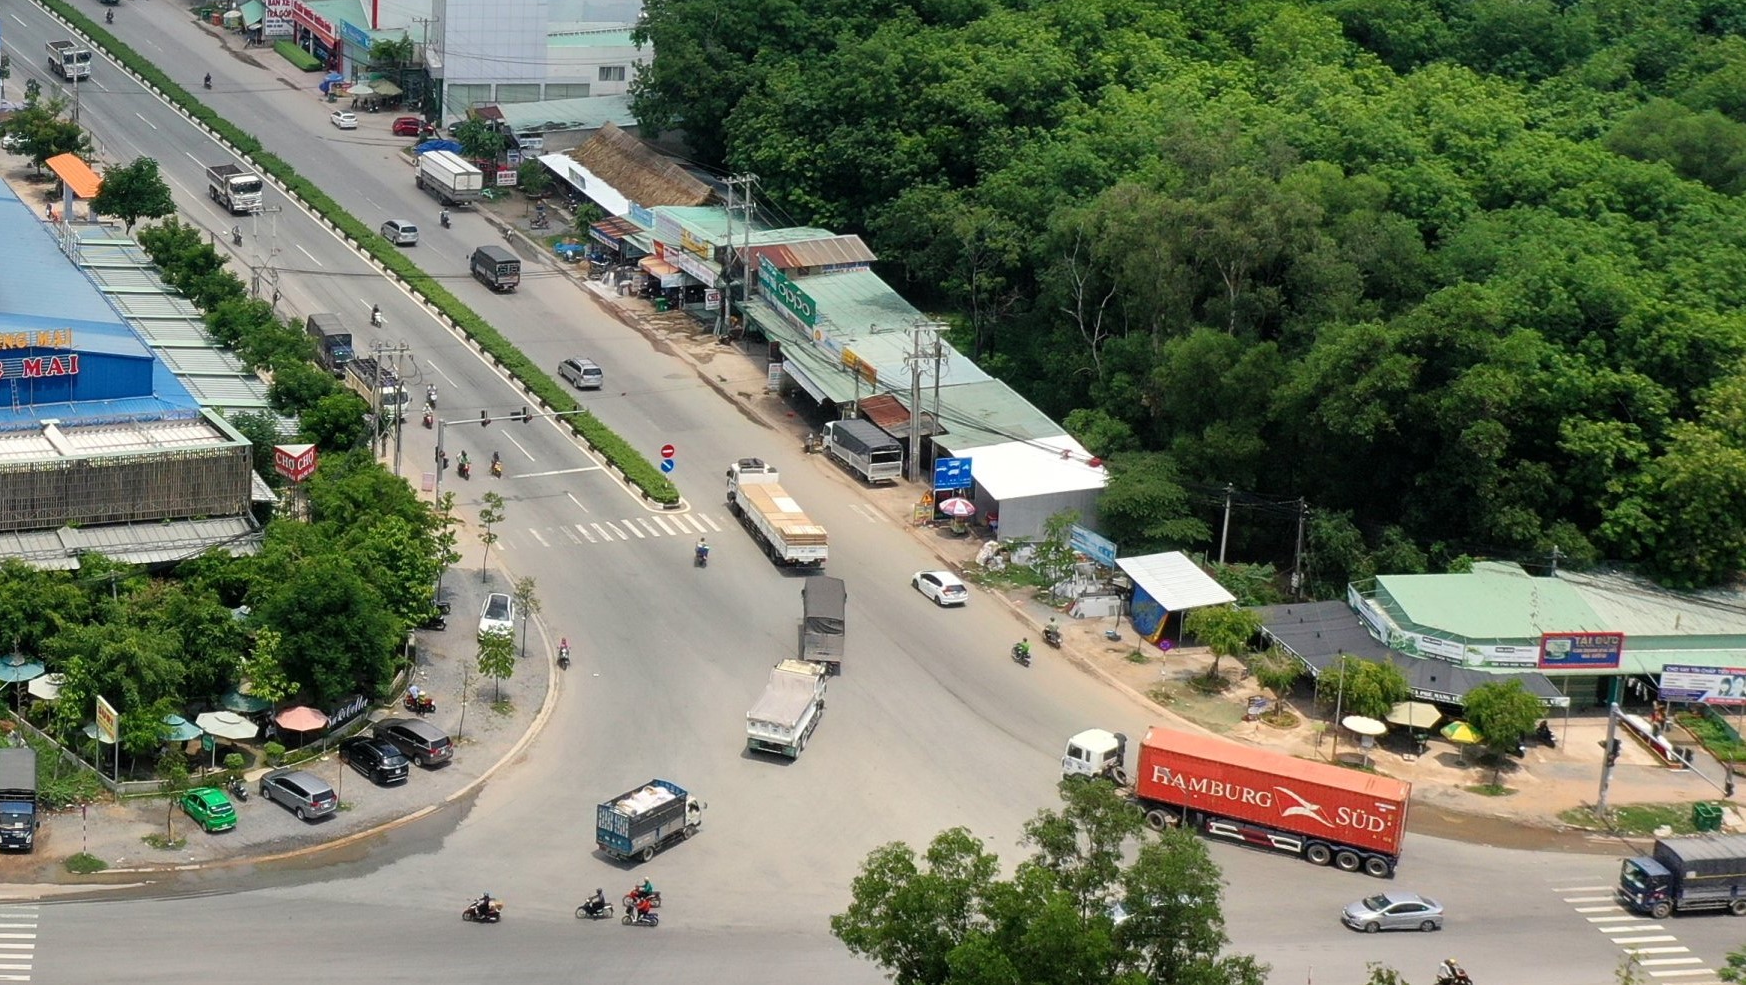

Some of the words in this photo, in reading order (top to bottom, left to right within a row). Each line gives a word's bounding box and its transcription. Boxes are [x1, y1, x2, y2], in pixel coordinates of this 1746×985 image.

[279, 8, 292, 18] GÓP
[36, 328, 74, 350] MẠI
[21, 354, 78, 379] MAI
[275, 452, 295, 474] CHỢ
[297, 447, 315, 471] CHỢ
[1151, 765, 1272, 808] HAMBURG
[1335, 806, 1385, 833] SÜD
